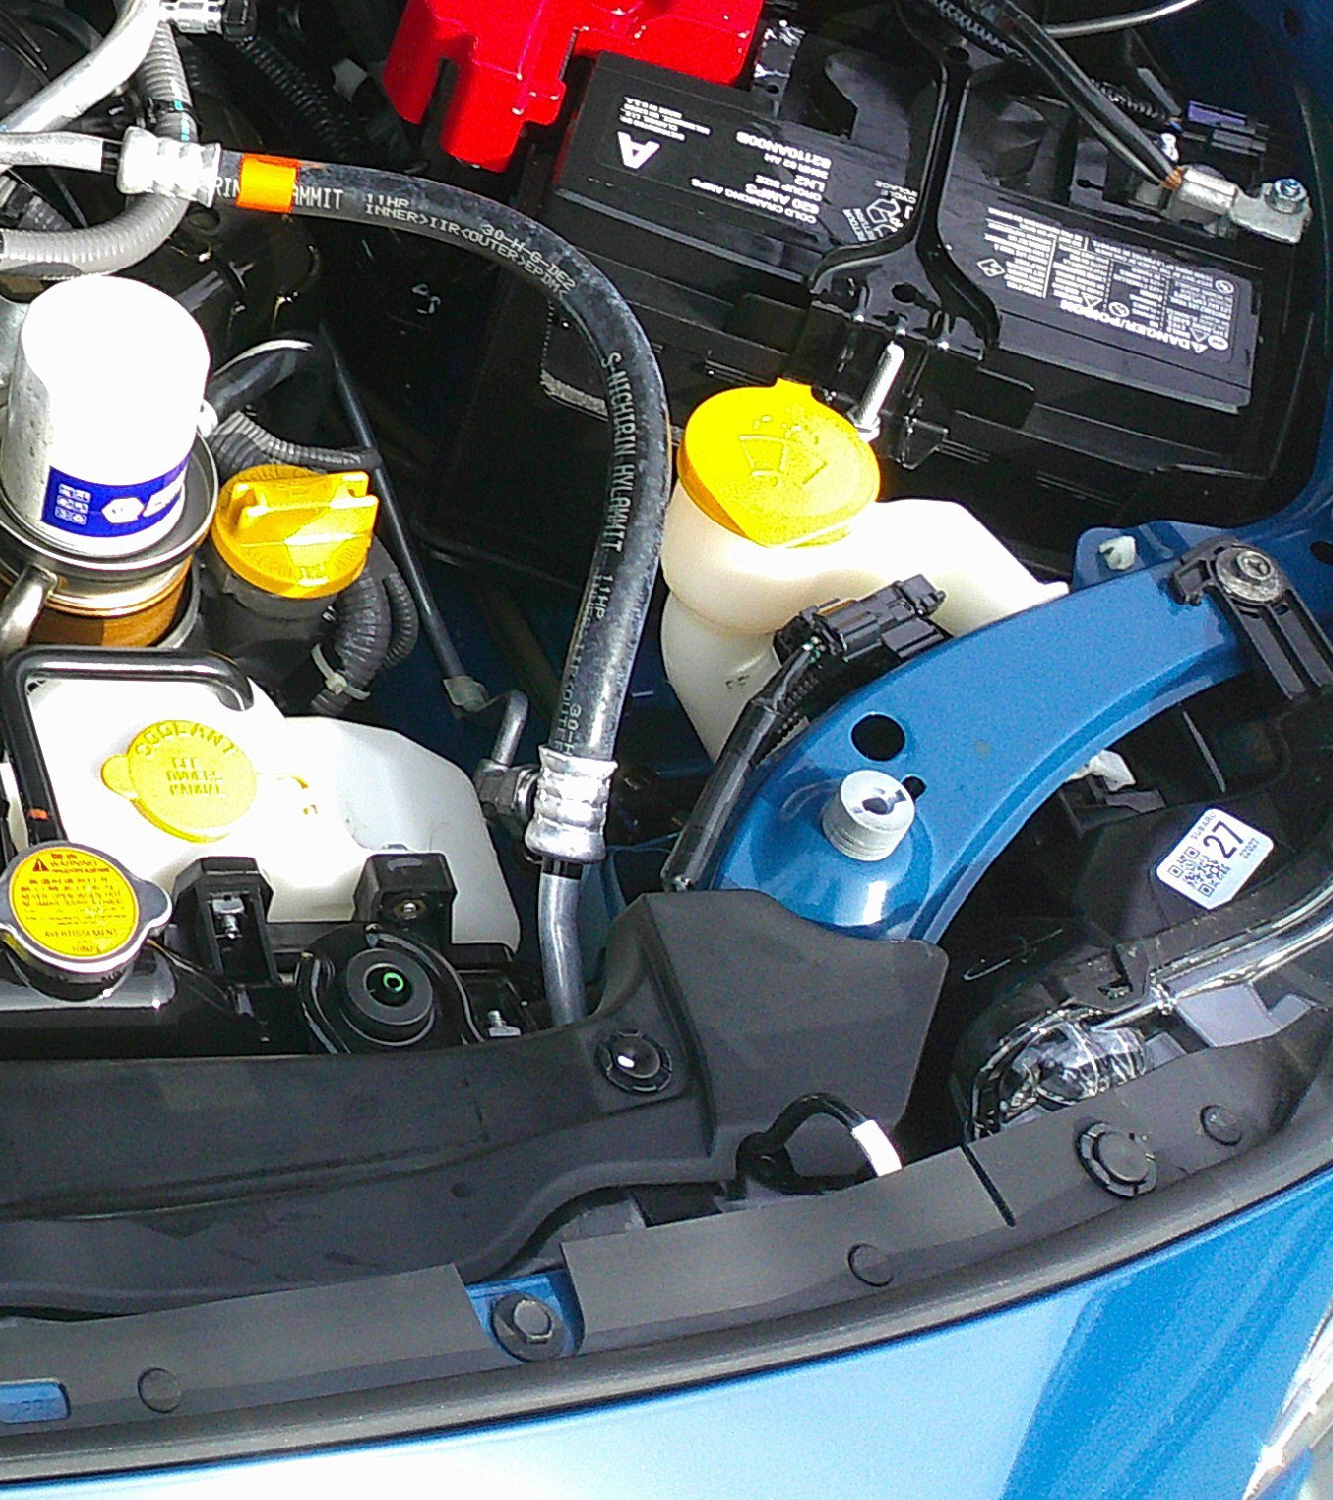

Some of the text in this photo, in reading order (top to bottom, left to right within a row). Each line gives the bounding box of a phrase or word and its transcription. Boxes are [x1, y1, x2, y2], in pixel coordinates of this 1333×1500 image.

[690, 178, 817, 224] COLD CRANKING AMPS
[744, 182, 790, 206] AMPS
[135, 723, 236, 755] COOLANT
[1202, 820, 1244, 859] 27
